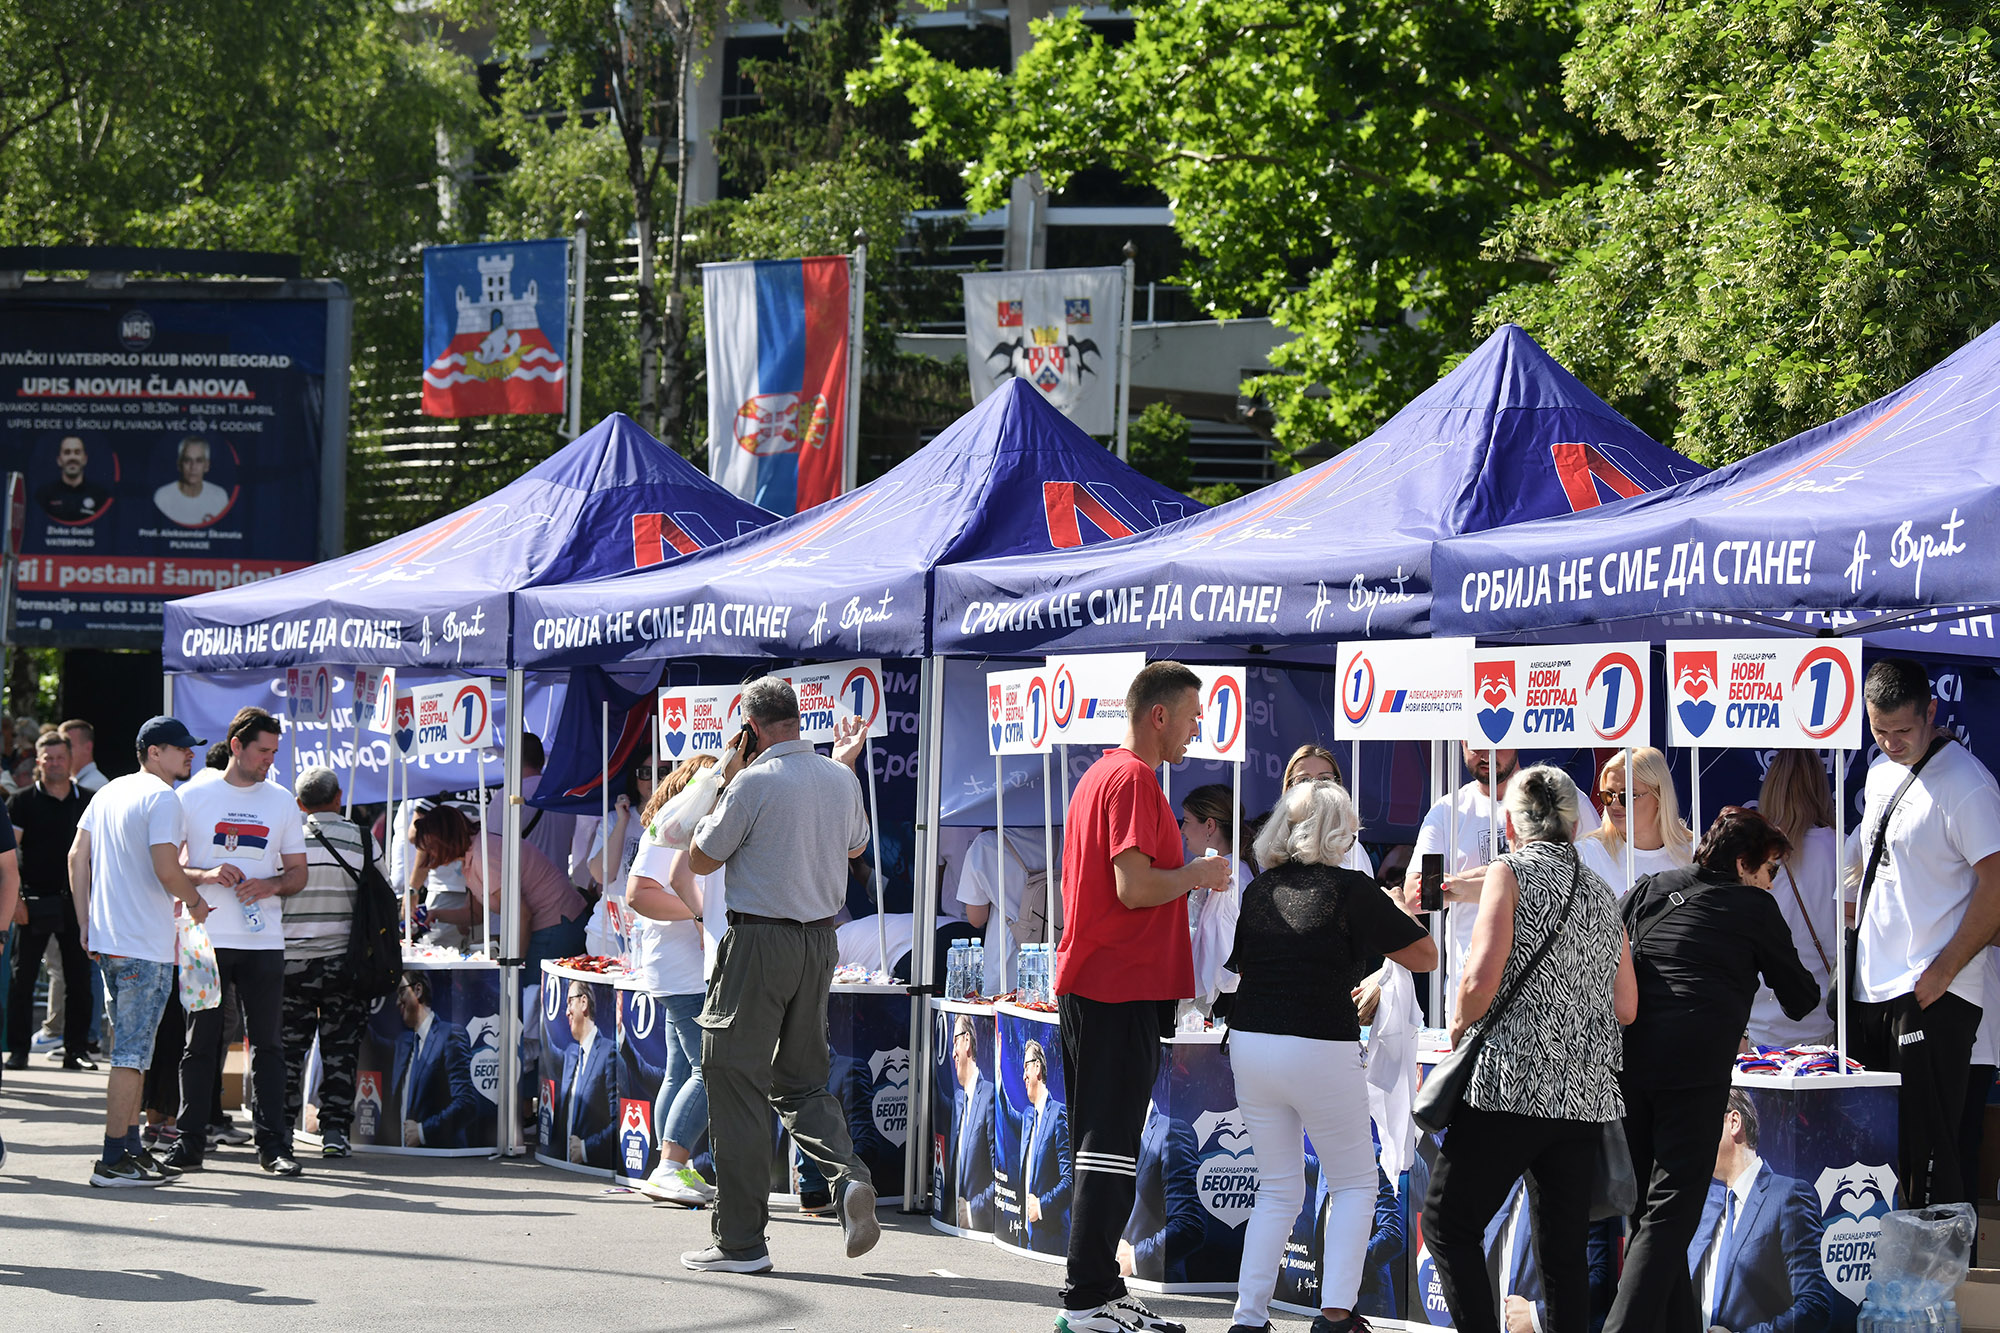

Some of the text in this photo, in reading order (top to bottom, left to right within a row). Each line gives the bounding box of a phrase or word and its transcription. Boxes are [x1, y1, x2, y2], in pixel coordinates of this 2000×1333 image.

[0, 350, 47, 366] IVAČKI
[57, 353, 140, 366] VATERPOLO
[141, 354, 179, 366] KLUB
[182, 354, 217, 367] NOVI
[219, 355, 290, 368] BEOGRAD
[22, 373, 250, 396] UPIS NOVIH ČLANOVA
[59, 561, 156, 588] postani
[162, 562, 282, 591] šampion
[1460, 564, 1552, 614] СРБИЈА
[1558, 557, 1594, 603] НЕ
[1599, 546, 1662, 597] СМЕ
[1663, 541, 1706, 598] ДА
[1712, 540, 1816, 586] СТАНЕ!
[960, 598, 1044, 635] СРБИЈА
[1049, 592, 1083, 628] НЕ
[1087, 586, 1144, 626] СМЕ
[1146, 584, 1183, 630] ДА
[1189, 585, 1283, 624] СТАНЕ!
[533, 614, 602, 651] СРБИЈА
[606, 611, 634, 643] НЕ
[638, 605, 685, 640] СМЕ
[686, 603, 717, 643] ДА
[720, 603, 792, 639] СТАНЕ!
[182, 626, 242, 657] СРБИЈА
[245, 624, 269, 653] НЕ
[271, 620, 311, 651] СМЕ
[309, 618, 337, 654] ДА
[1528, 670, 1560, 688] НОВИ
[1731, 662, 1765, 680] НОВИ
[800, 682, 822, 697] НОВИ
[1353, 669, 1362, 702] 1
[1728, 682, 1783, 701] БЕОГРАД
[1810, 661, 1832, 727] 1
[800, 695, 835, 711] БЕОГРАД
[1408, 690, 1463, 700] АЛЕКСАНДАР ВУЧИЋ
[1526, 688, 1577, 706] БЕОГРАД
[1602, 667, 1622, 730] 1
[420, 700, 438, 713] НОВИ
[462, 694, 474, 737] 1
[694, 704, 712, 717] НОВИ
[1032, 688, 1040, 739] 1
[1217, 688, 1229, 742] 1
[1405, 703, 1463, 714] НОВИ БЕОГРАД СУТРА
[1726, 702, 1780, 728] СУТРА
[419, 711, 448, 726] БЕОГРАД
[693, 717, 723, 730] БЕОГРАД
[1523, 708, 1574, 734] СУТРА
[419, 725, 447, 744] СУТРА
[692, 731, 722, 750] СУТРА
[1005, 722, 1023, 743] СУТРА
[1899, 1030, 1924, 1047] PUMA
[474, 1064, 500, 1077] БЕОГ
[481, 1077, 499, 1089] СУТ
[876, 1103, 908, 1117] БЕОГР
[884, 1118, 907, 1131] СУТР
[1212, 1193, 1255, 1208] СУТРА
[1832, 1232, 1865, 1241] АЛЕКСАНДАР
[1826, 1241, 1876, 1263] БЕОГРА
[1836, 1263, 1872, 1283] СУТР
[1427, 1294, 1449, 1312] СУТР
